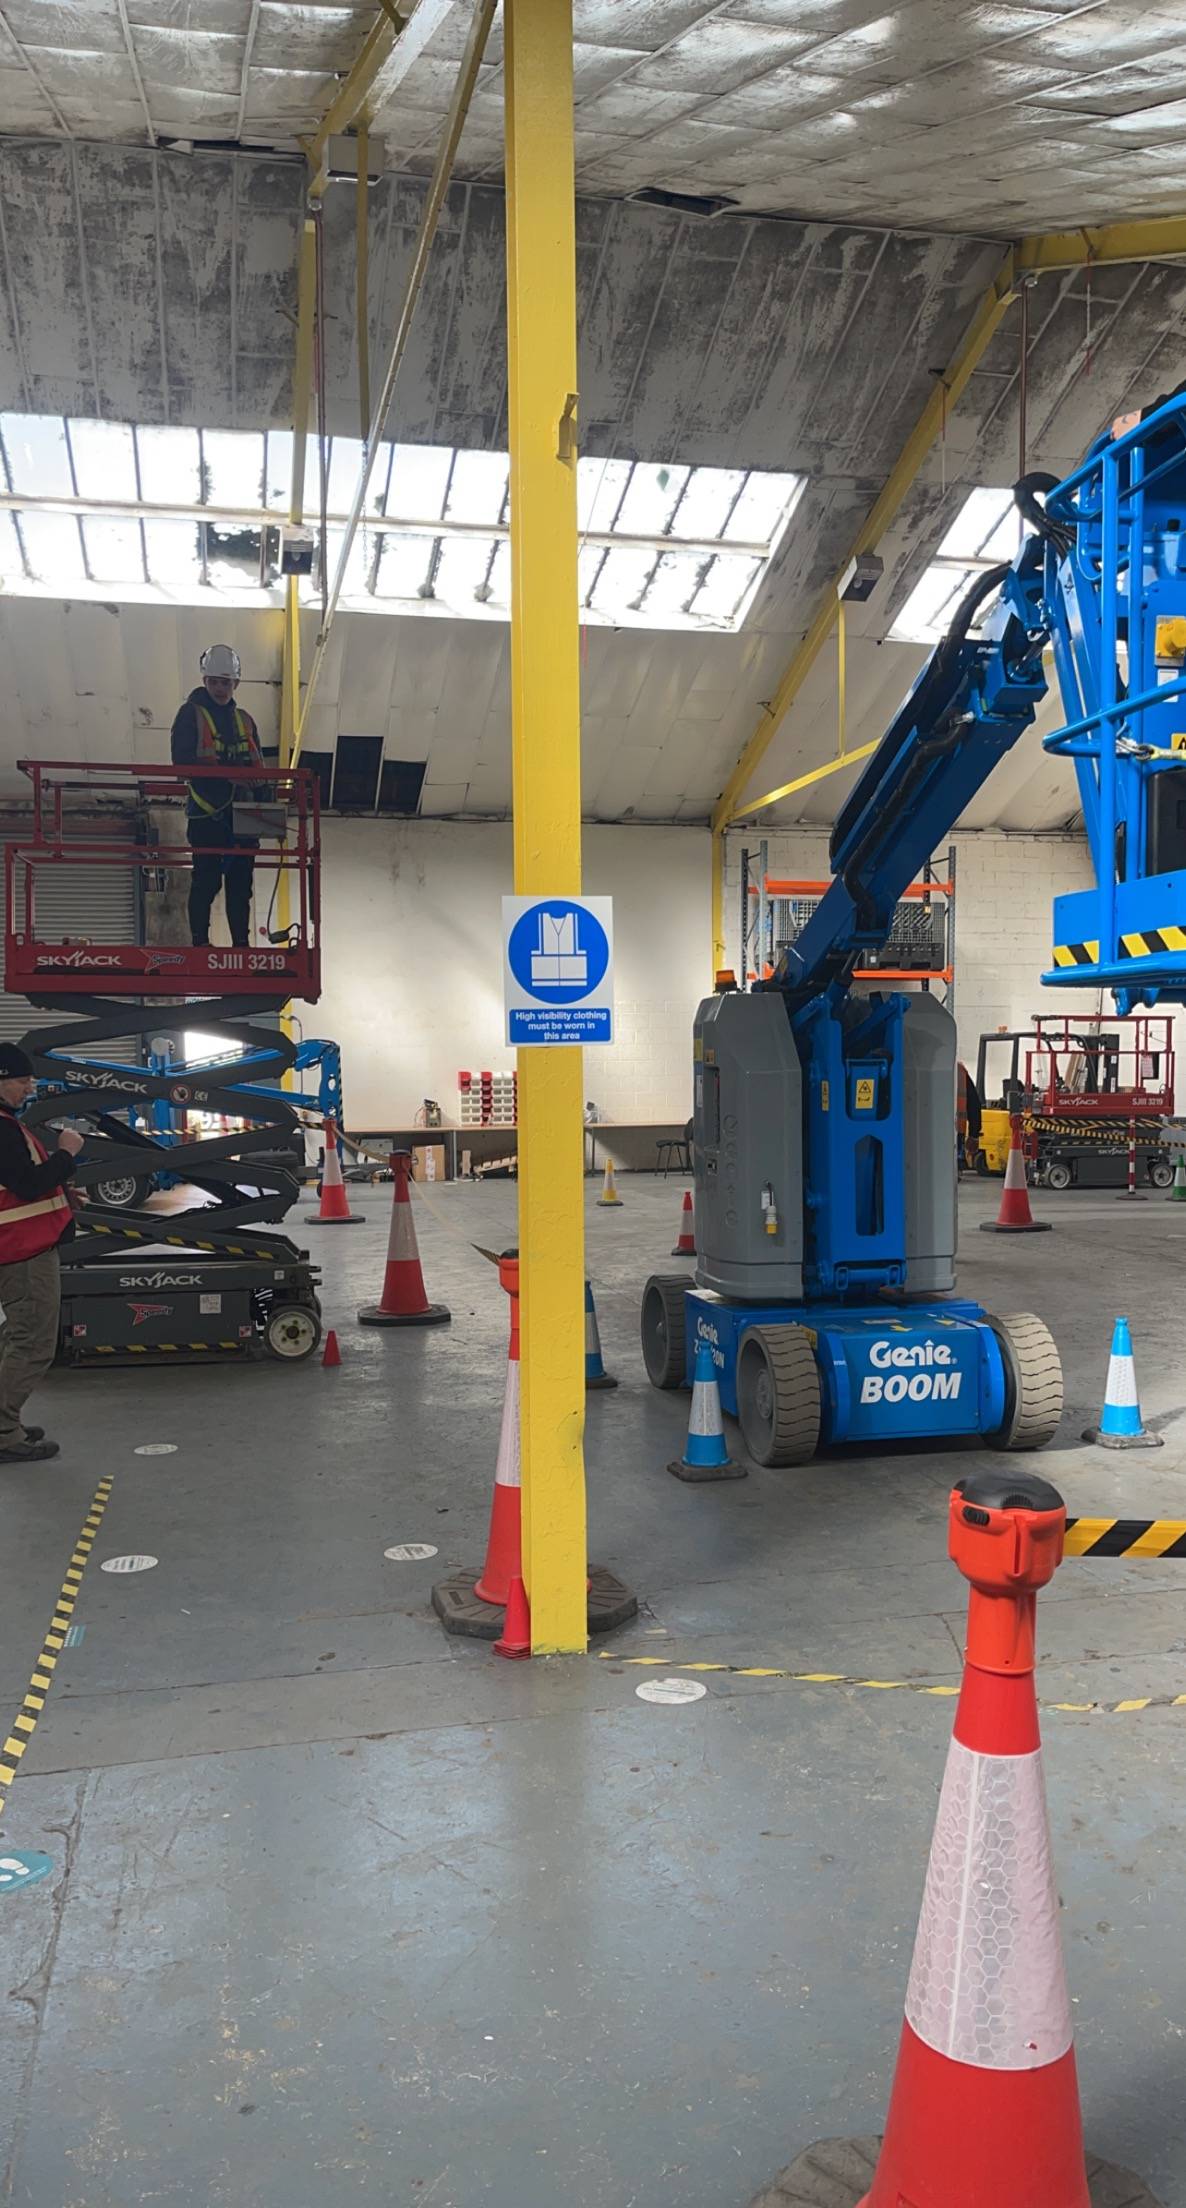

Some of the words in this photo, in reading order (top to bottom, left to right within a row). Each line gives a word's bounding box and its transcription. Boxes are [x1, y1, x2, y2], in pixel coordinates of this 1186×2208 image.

[36, 950, 122, 967] SKYJACK
[207, 953, 243, 970] SJIII
[247, 954, 286, 970] 3219
[515, 1012, 536, 1022] High
[537, 1012, 572, 1021] visibility
[573, 1011, 608, 1021] clothing
[528, 1022, 550, 1030] must
[551, 1022, 563, 1030] be
[564, 1022, 586, 1030] worn
[587, 1021, 596, 1029] in
[544, 1032, 560, 1040] this
[561, 1032, 581, 1040] area
[65, 1070, 148, 1095] SKYJACK
[1058, 1097, 1099, 1106] SKYJACK
[119, 1271, 203, 1288] SKYJACK
[697, 1315, 719, 1345] Genie
[869, 1339, 952, 1369] Genie
[860, 1372, 962, 1404] BOOM
